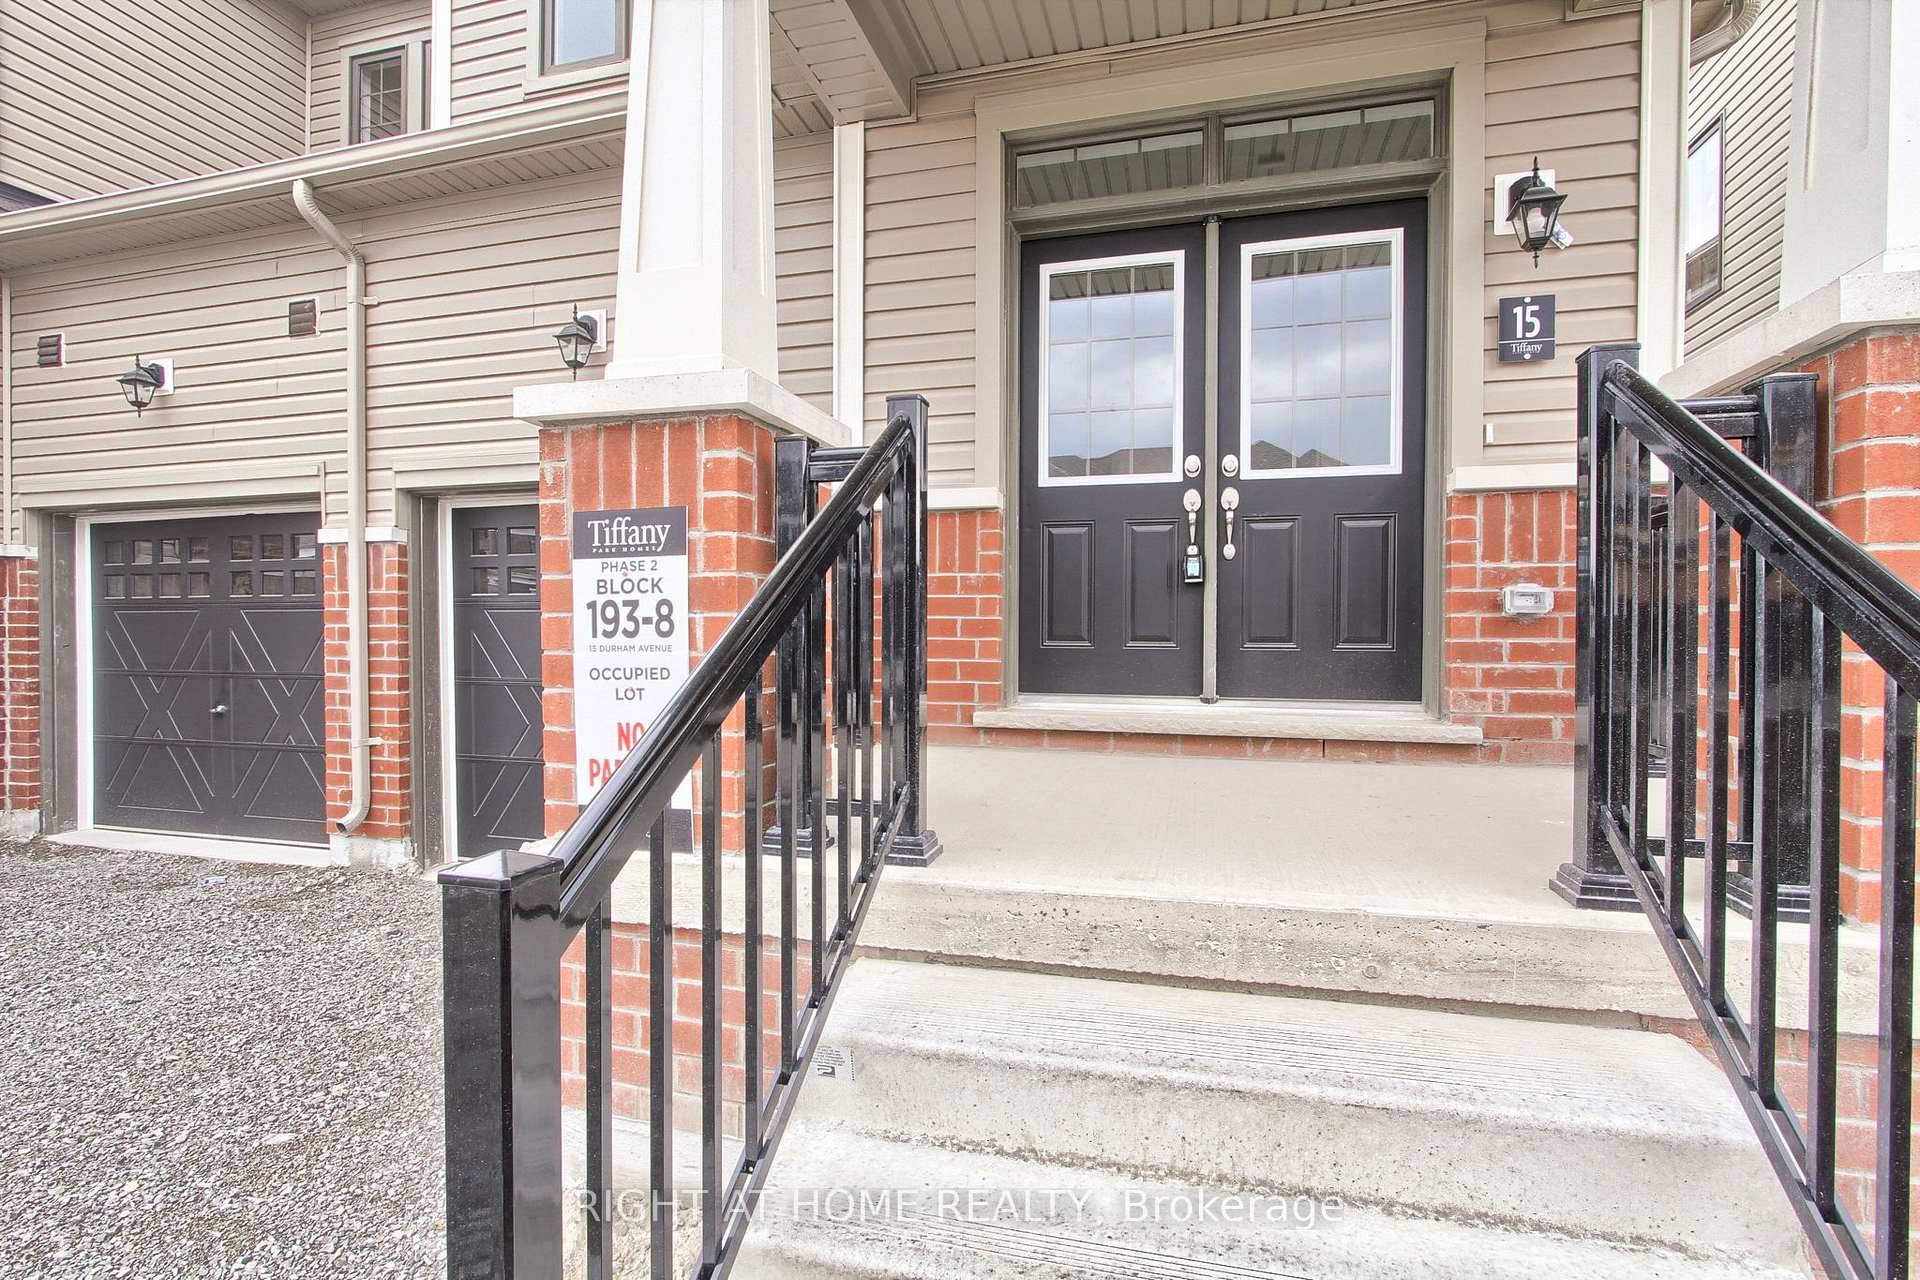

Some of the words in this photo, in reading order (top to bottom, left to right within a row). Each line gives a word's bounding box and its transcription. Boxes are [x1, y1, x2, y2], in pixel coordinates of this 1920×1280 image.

[1513, 305, 1541, 338] 15
[1510, 343, 1542, 352] Tiffany
[588, 516, 671, 552] Tiffany
[601, 560, 646, 572] PHASE
[650, 560, 658, 571] 2
[597, 578, 664, 594] BLOCK
[586, 598, 674, 638] 193-8
[600, 644, 636, 652] DURHAM
[638, 644, 672, 652] AVENUE
[589, 668, 670, 680] OCCUPIED
[616, 687, 645, 700] LOT
